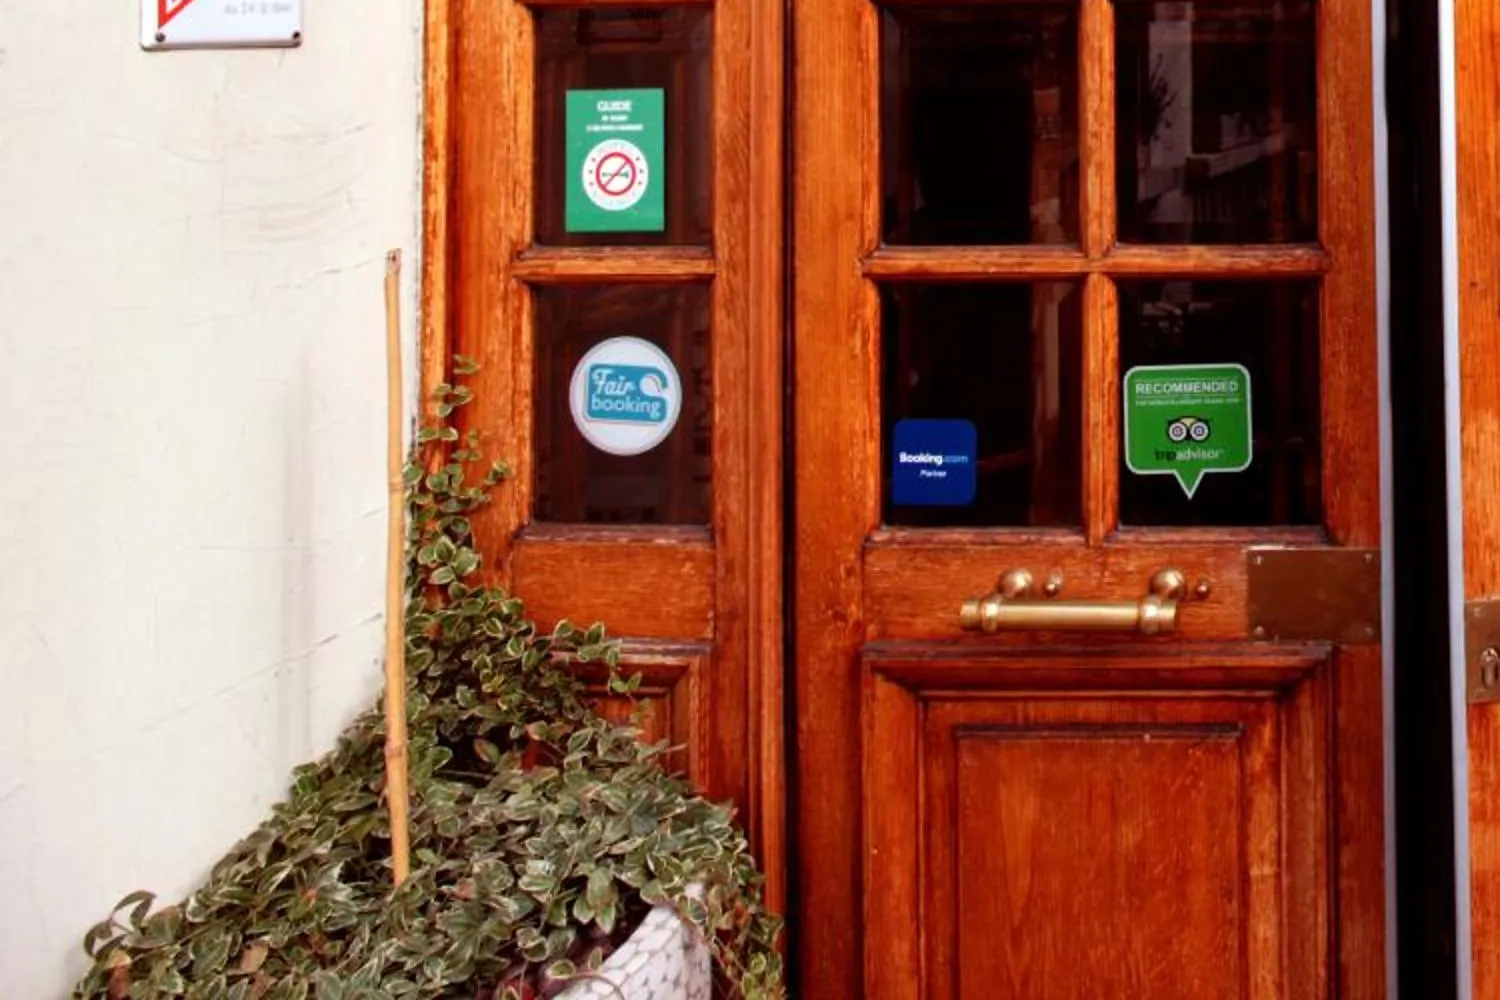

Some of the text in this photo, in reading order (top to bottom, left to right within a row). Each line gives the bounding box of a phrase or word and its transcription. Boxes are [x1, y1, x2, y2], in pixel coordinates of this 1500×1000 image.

[591, 367, 637, 396] Fair
[1135, 380, 1239, 395] RECOMMENDED
[591, 394, 661, 419] booking
